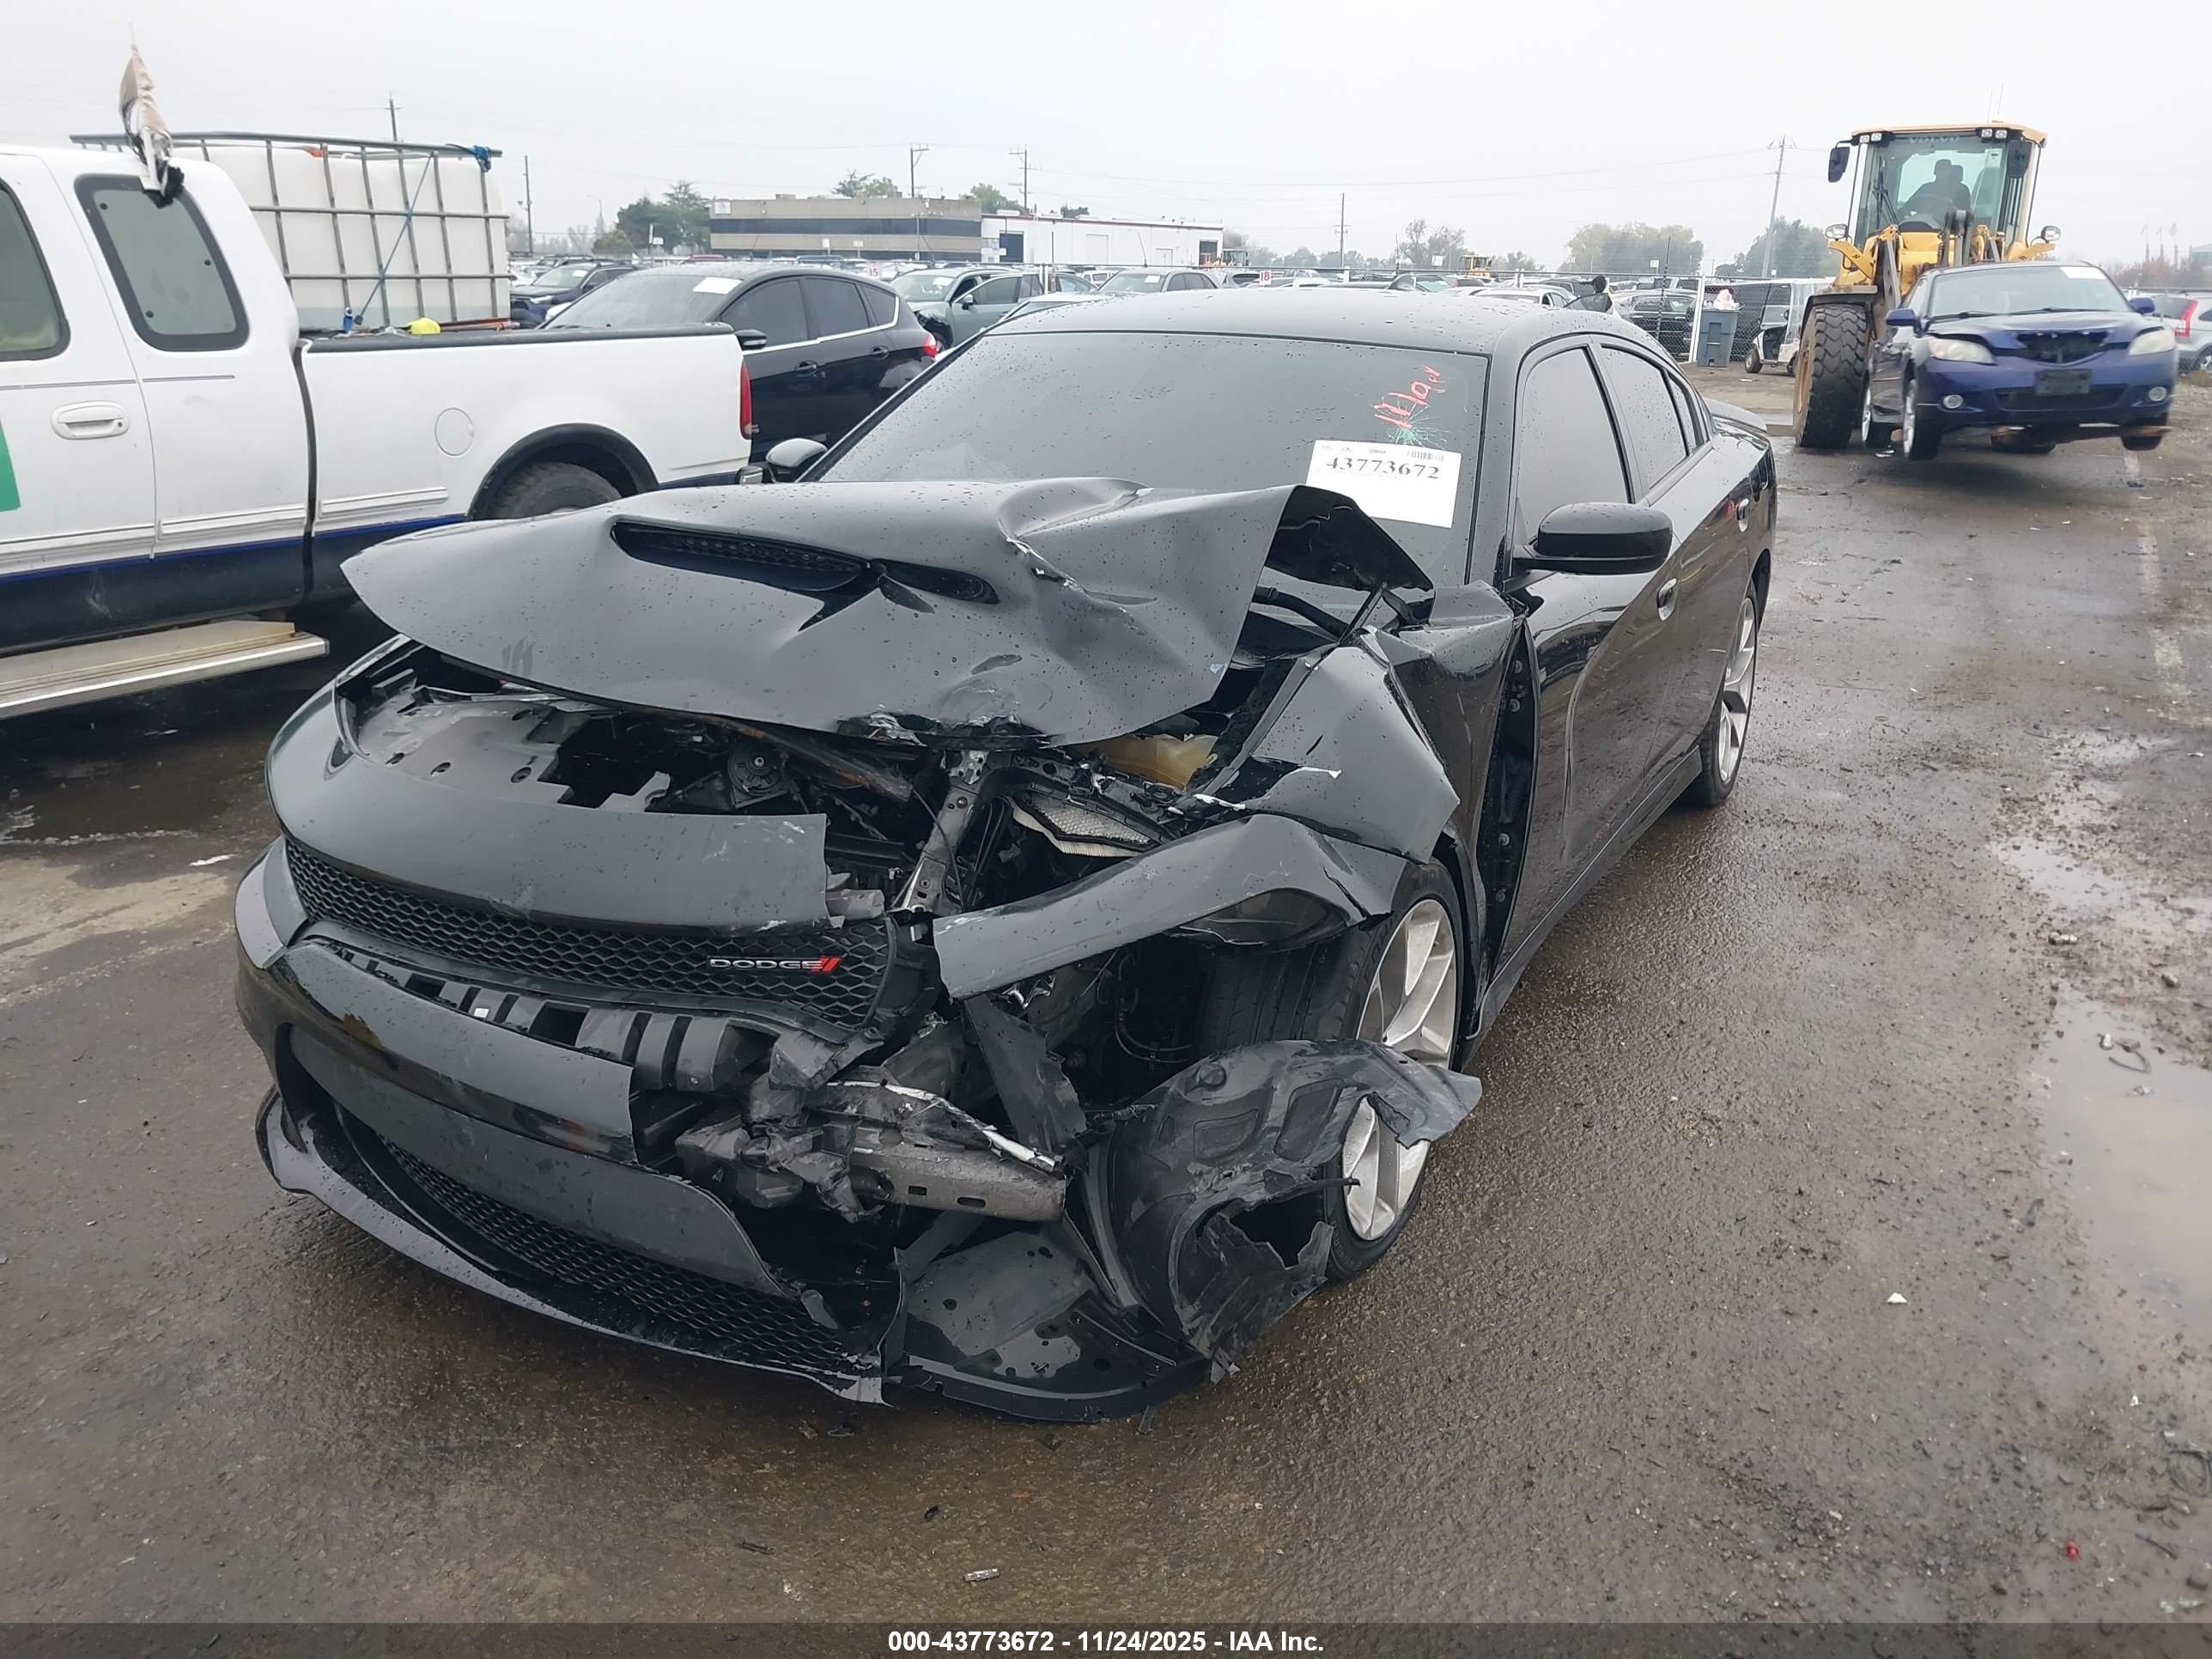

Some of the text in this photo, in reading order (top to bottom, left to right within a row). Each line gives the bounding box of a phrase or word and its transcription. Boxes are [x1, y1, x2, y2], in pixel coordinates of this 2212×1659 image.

[1261, 271, 1270, 282] 18
[1326, 456, 1440, 479] 43773672
[709, 958, 823, 969] DODGE
